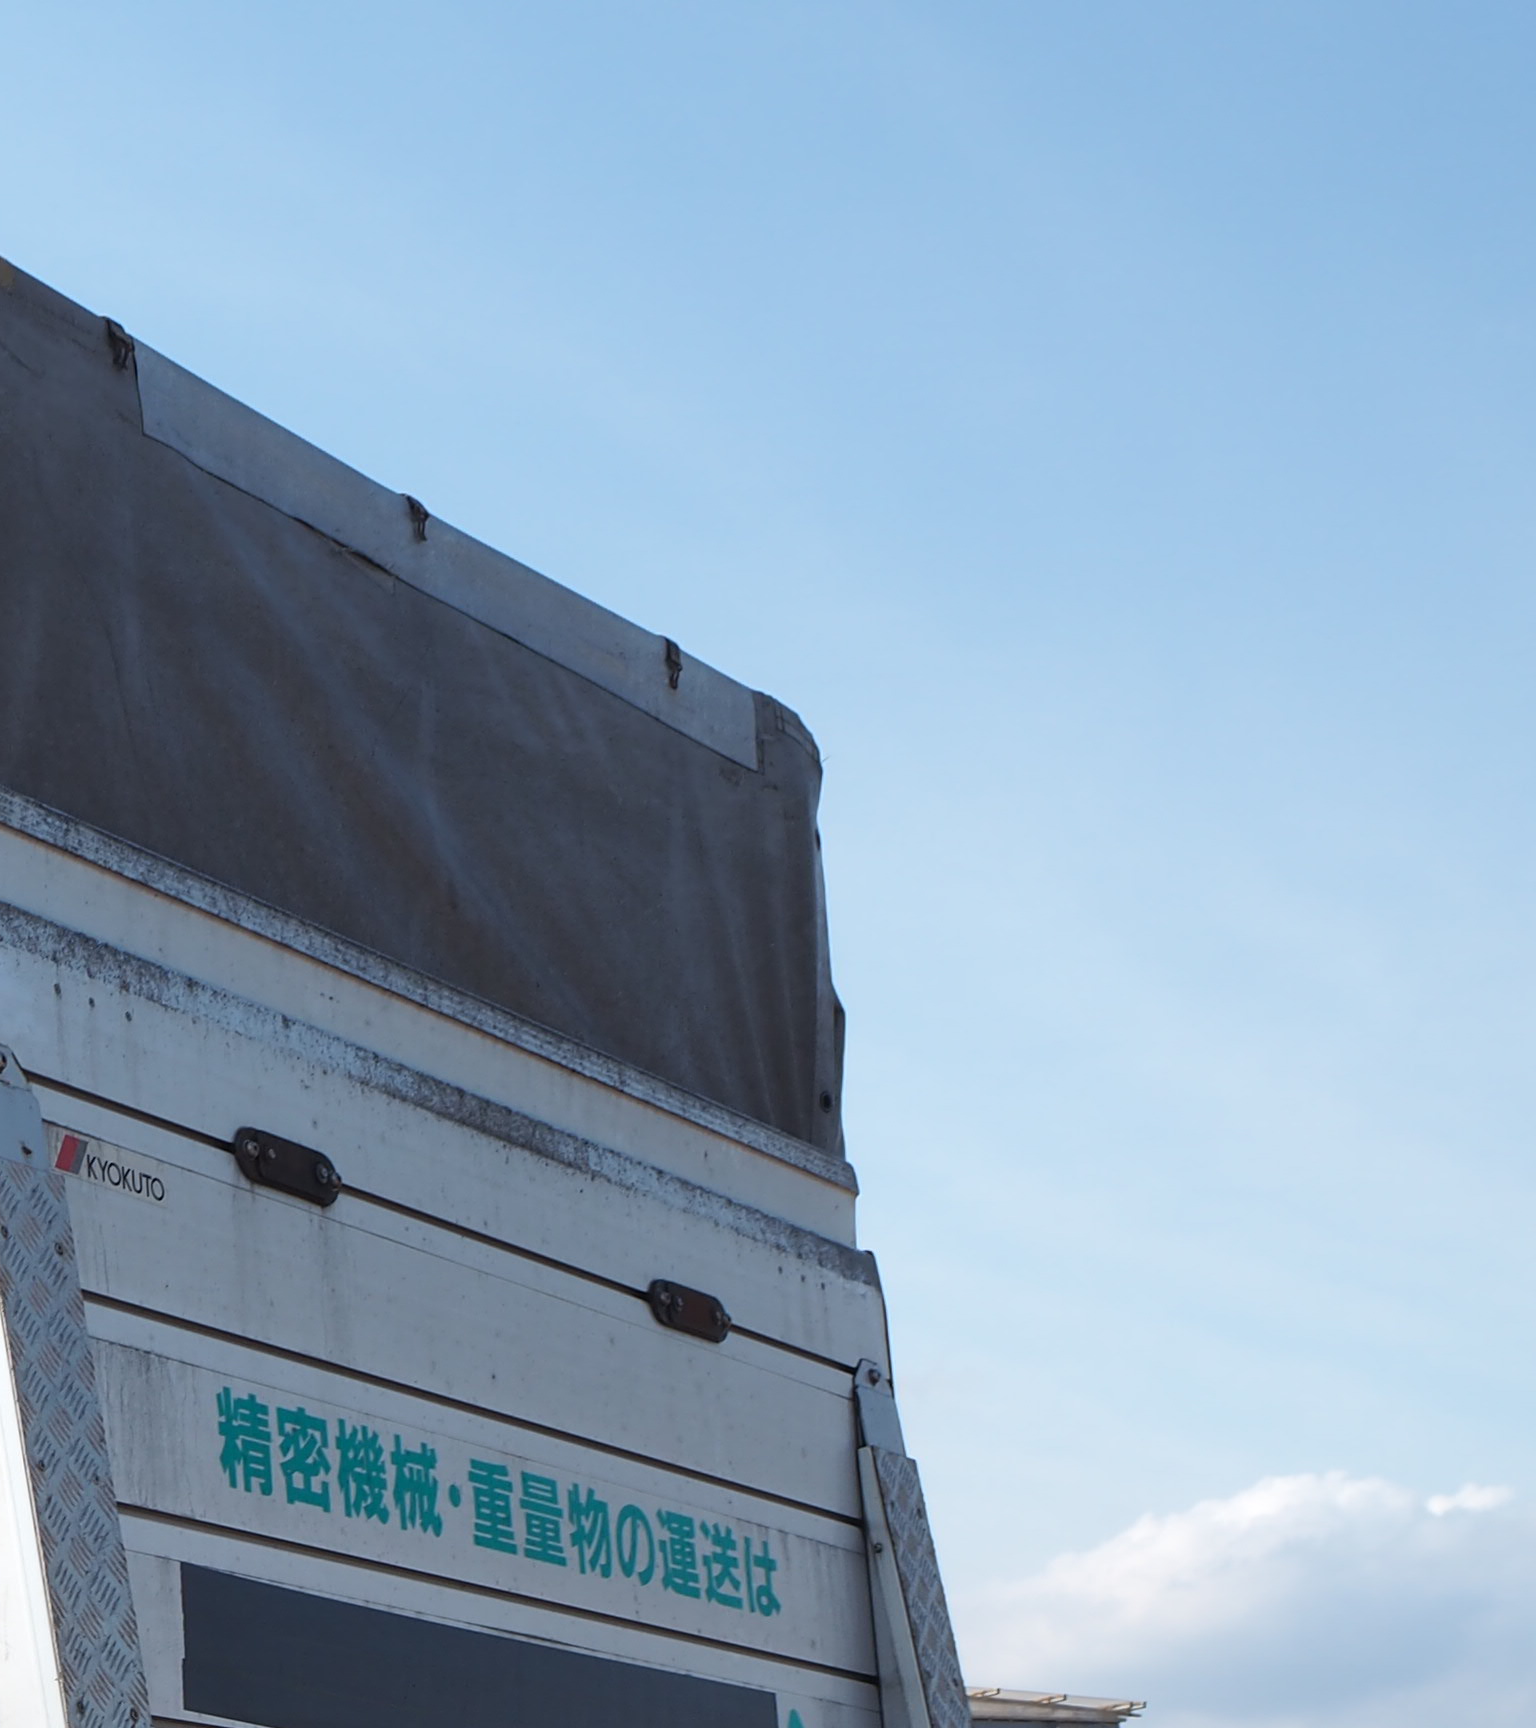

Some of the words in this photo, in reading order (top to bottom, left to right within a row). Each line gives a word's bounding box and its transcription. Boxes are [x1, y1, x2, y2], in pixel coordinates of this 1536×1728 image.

[86, 1153, 166, 1202] KYOKUTO
[215, 1386, 782, 1617] 精密機械・重量物の運送は
